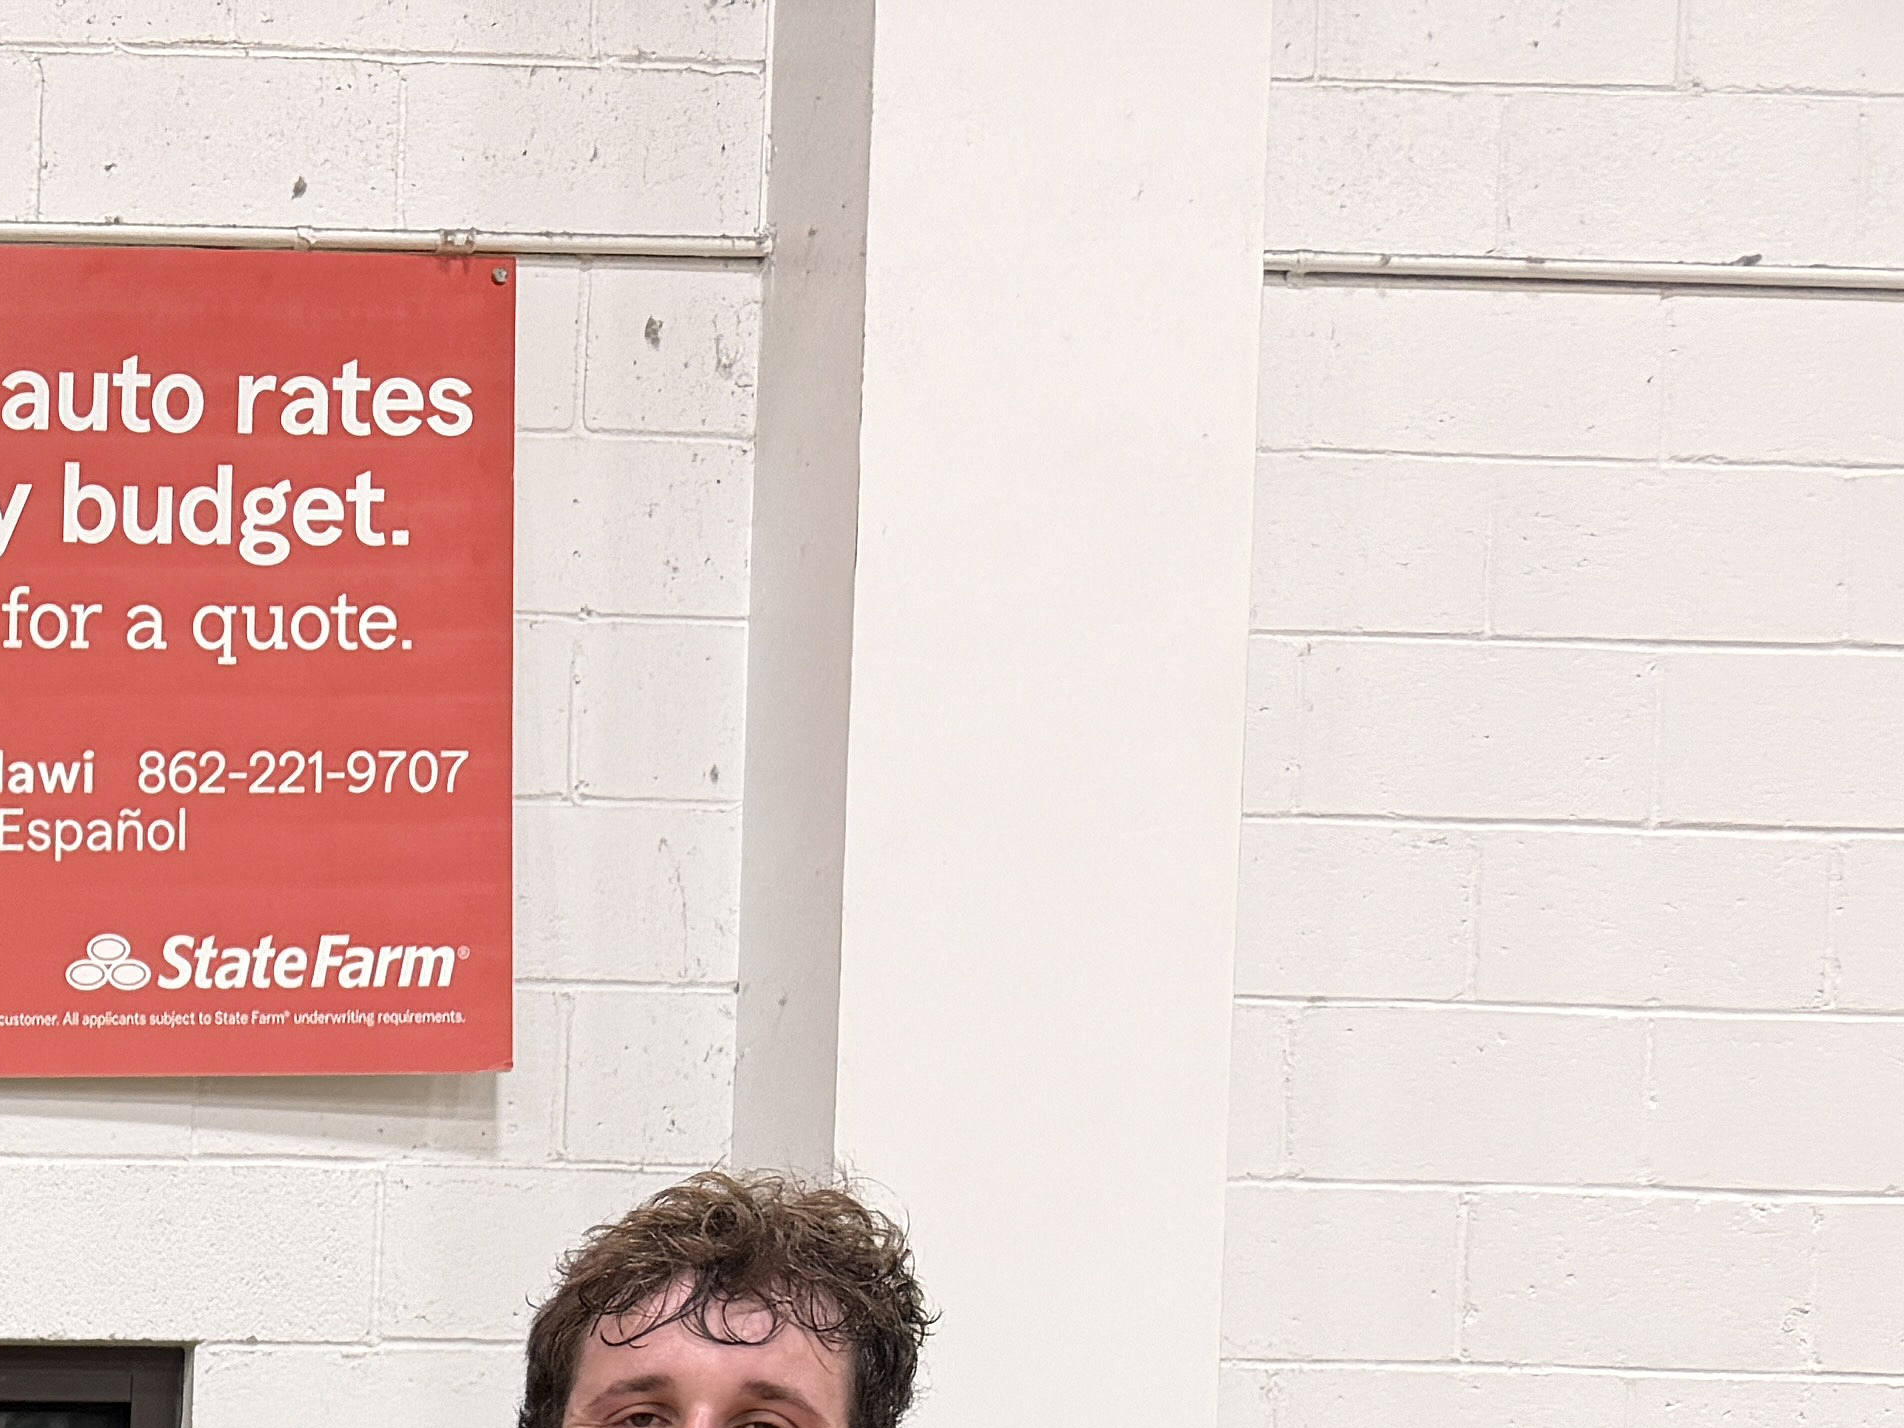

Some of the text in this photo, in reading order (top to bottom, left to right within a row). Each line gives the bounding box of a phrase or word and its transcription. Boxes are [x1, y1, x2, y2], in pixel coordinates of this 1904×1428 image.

[2, 356, 204, 433] auto
[238, 360, 472, 436] rates
[63, 462, 411, 566] budget.
[2, 586, 102, 649] for
[127, 605, 167, 650] a
[193, 594, 413, 664] quote.
[137, 750, 468, 794] 862-221-9707
[62, 1011, 79, 1026] All
[82, 1011, 146, 1028] applicants
[149, 1011, 196, 1028] subject
[198, 1011, 212, 1026] to
[214, 1010, 248, 1026] State
[293, 1010, 375, 1028] underwriting
